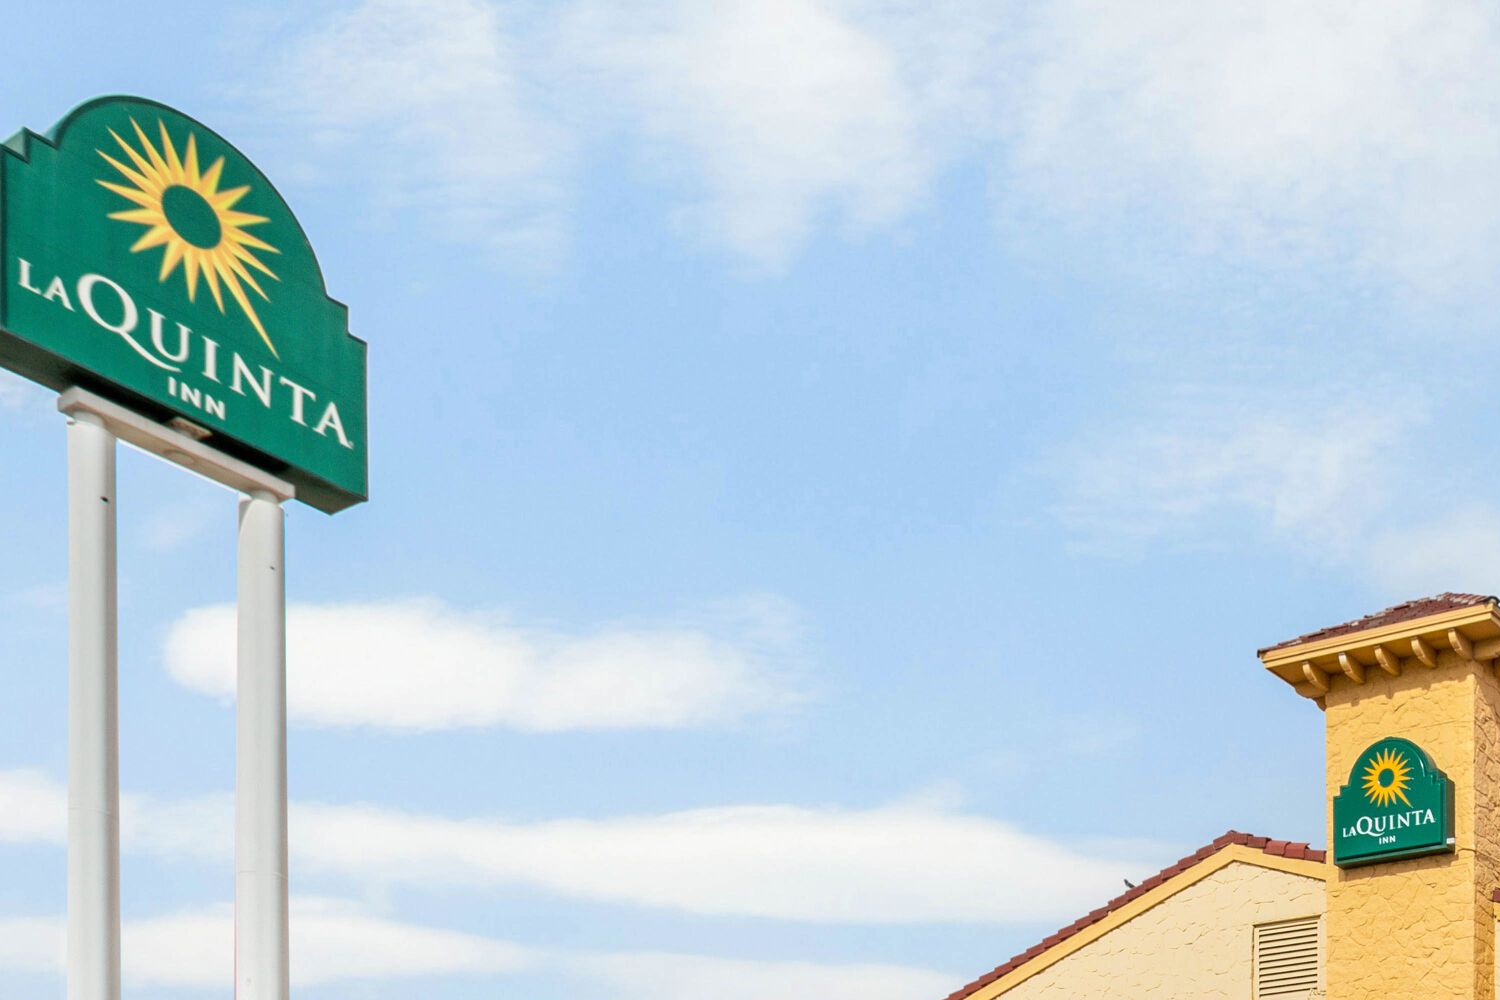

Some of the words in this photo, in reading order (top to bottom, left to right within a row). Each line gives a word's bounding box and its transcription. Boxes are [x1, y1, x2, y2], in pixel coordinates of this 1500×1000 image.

[17, 257, 76, 312] LA
[77, 273, 354, 450] QUINTA
[168, 376, 226, 421] INN
[1356, 808, 1435, 836] QUINTA
[1379, 835, 1396, 844] INN
